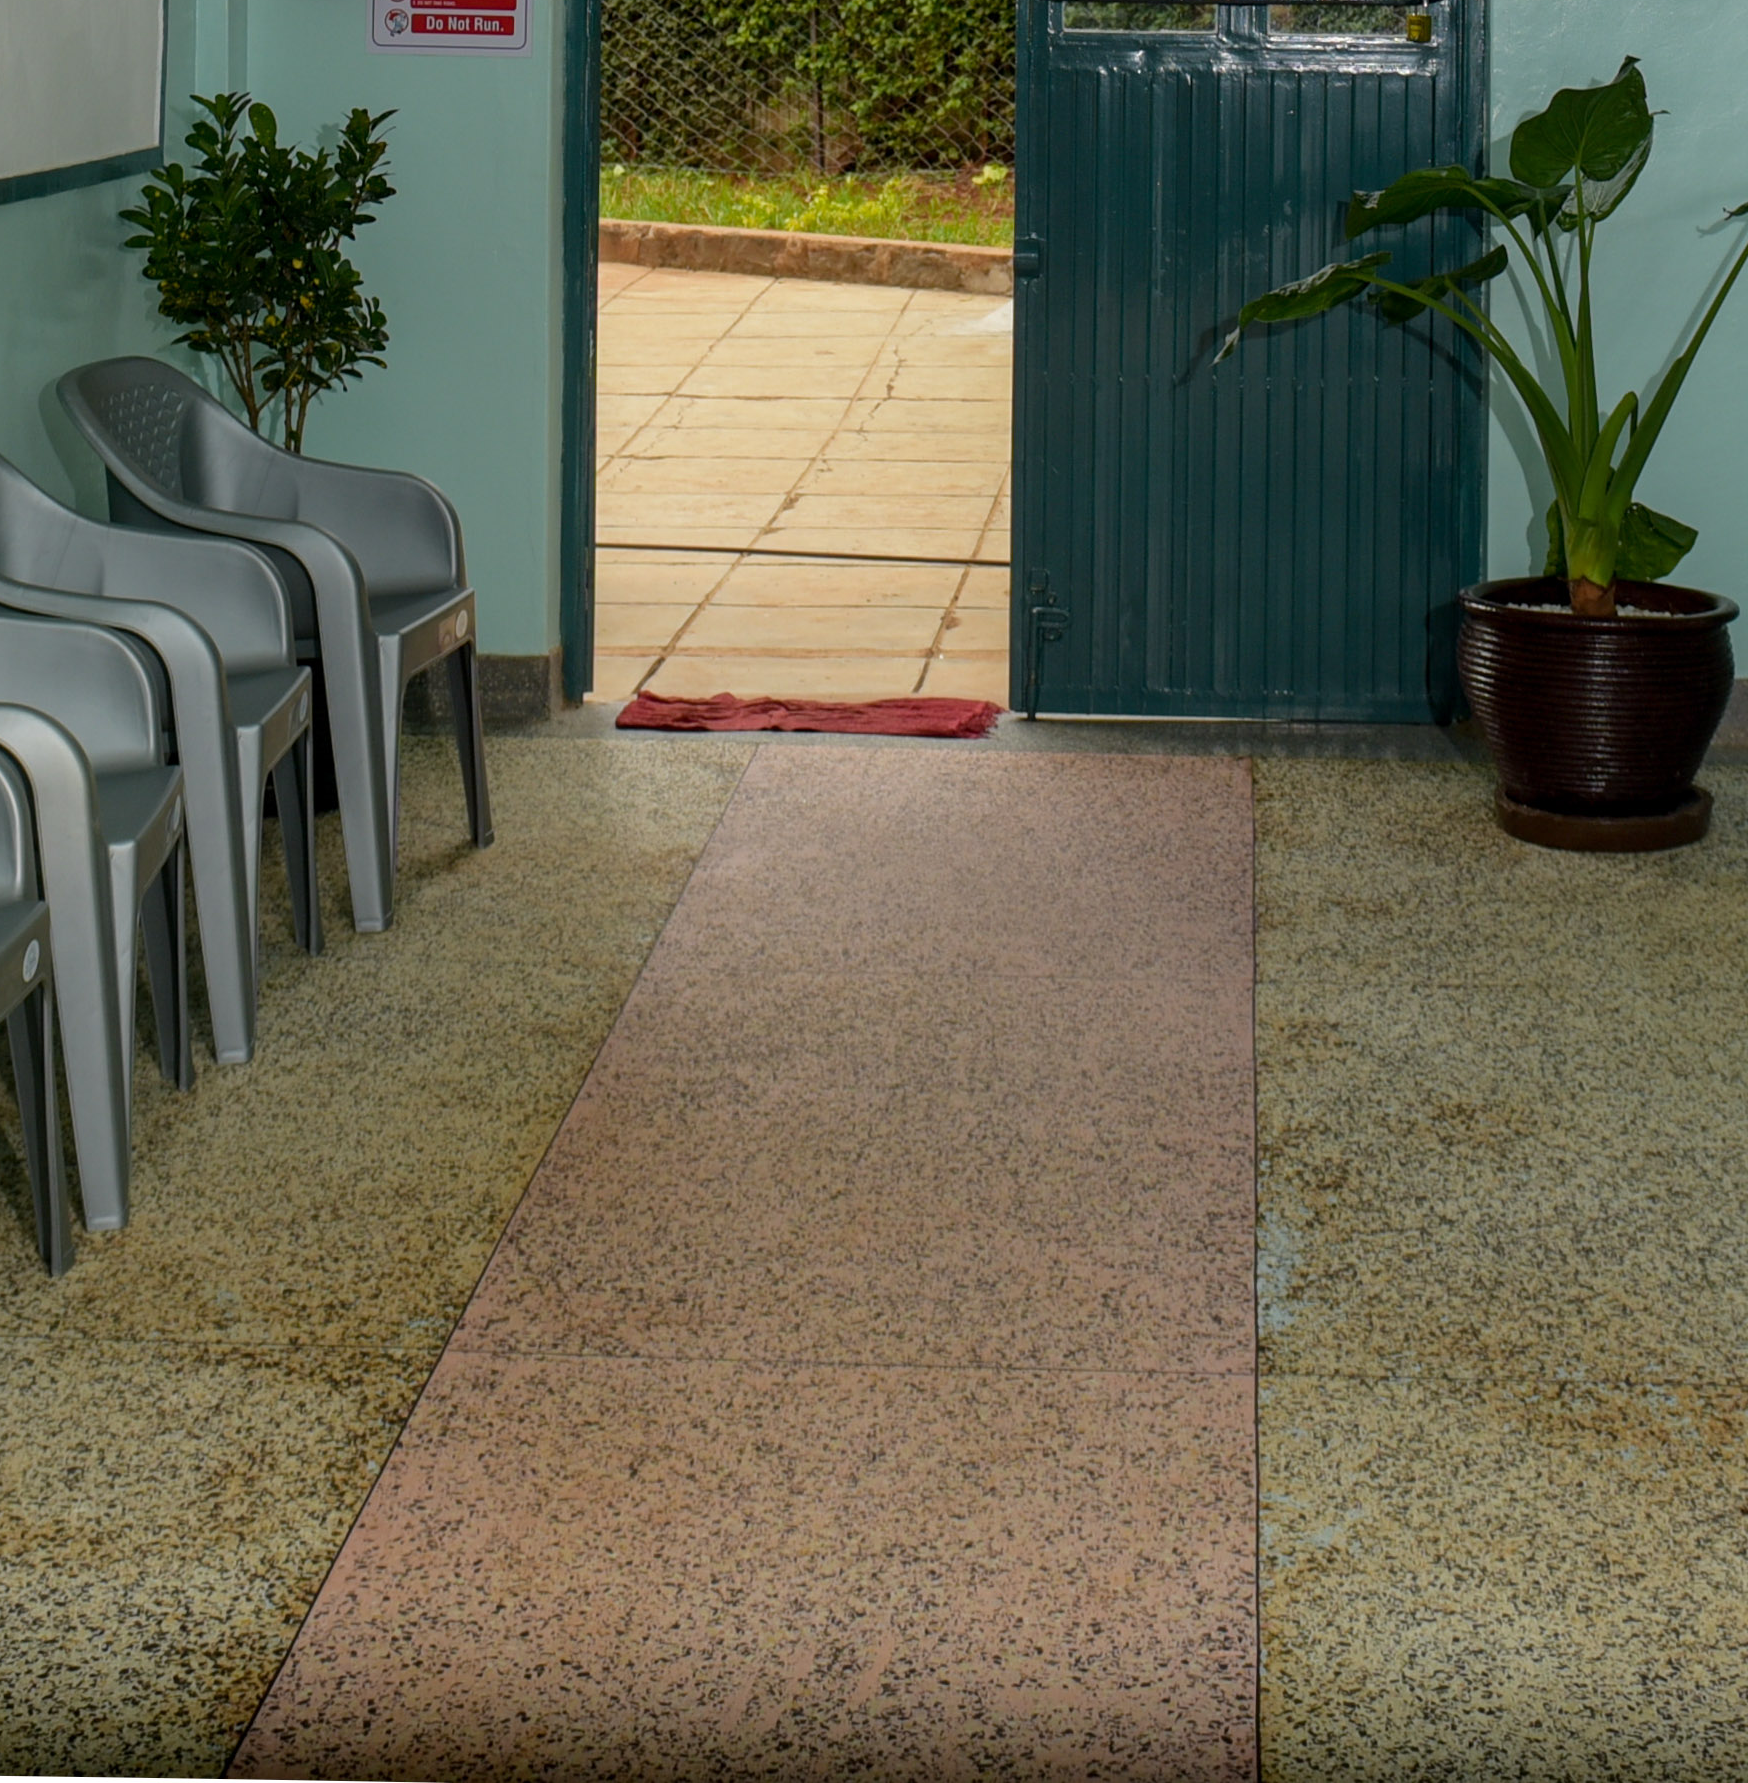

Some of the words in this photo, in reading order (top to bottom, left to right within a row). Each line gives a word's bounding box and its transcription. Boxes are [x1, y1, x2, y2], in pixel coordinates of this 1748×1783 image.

[426, 16, 444, 30] Do
[448, 17, 470, 31] Not
[474, 17, 505, 32] Run.
